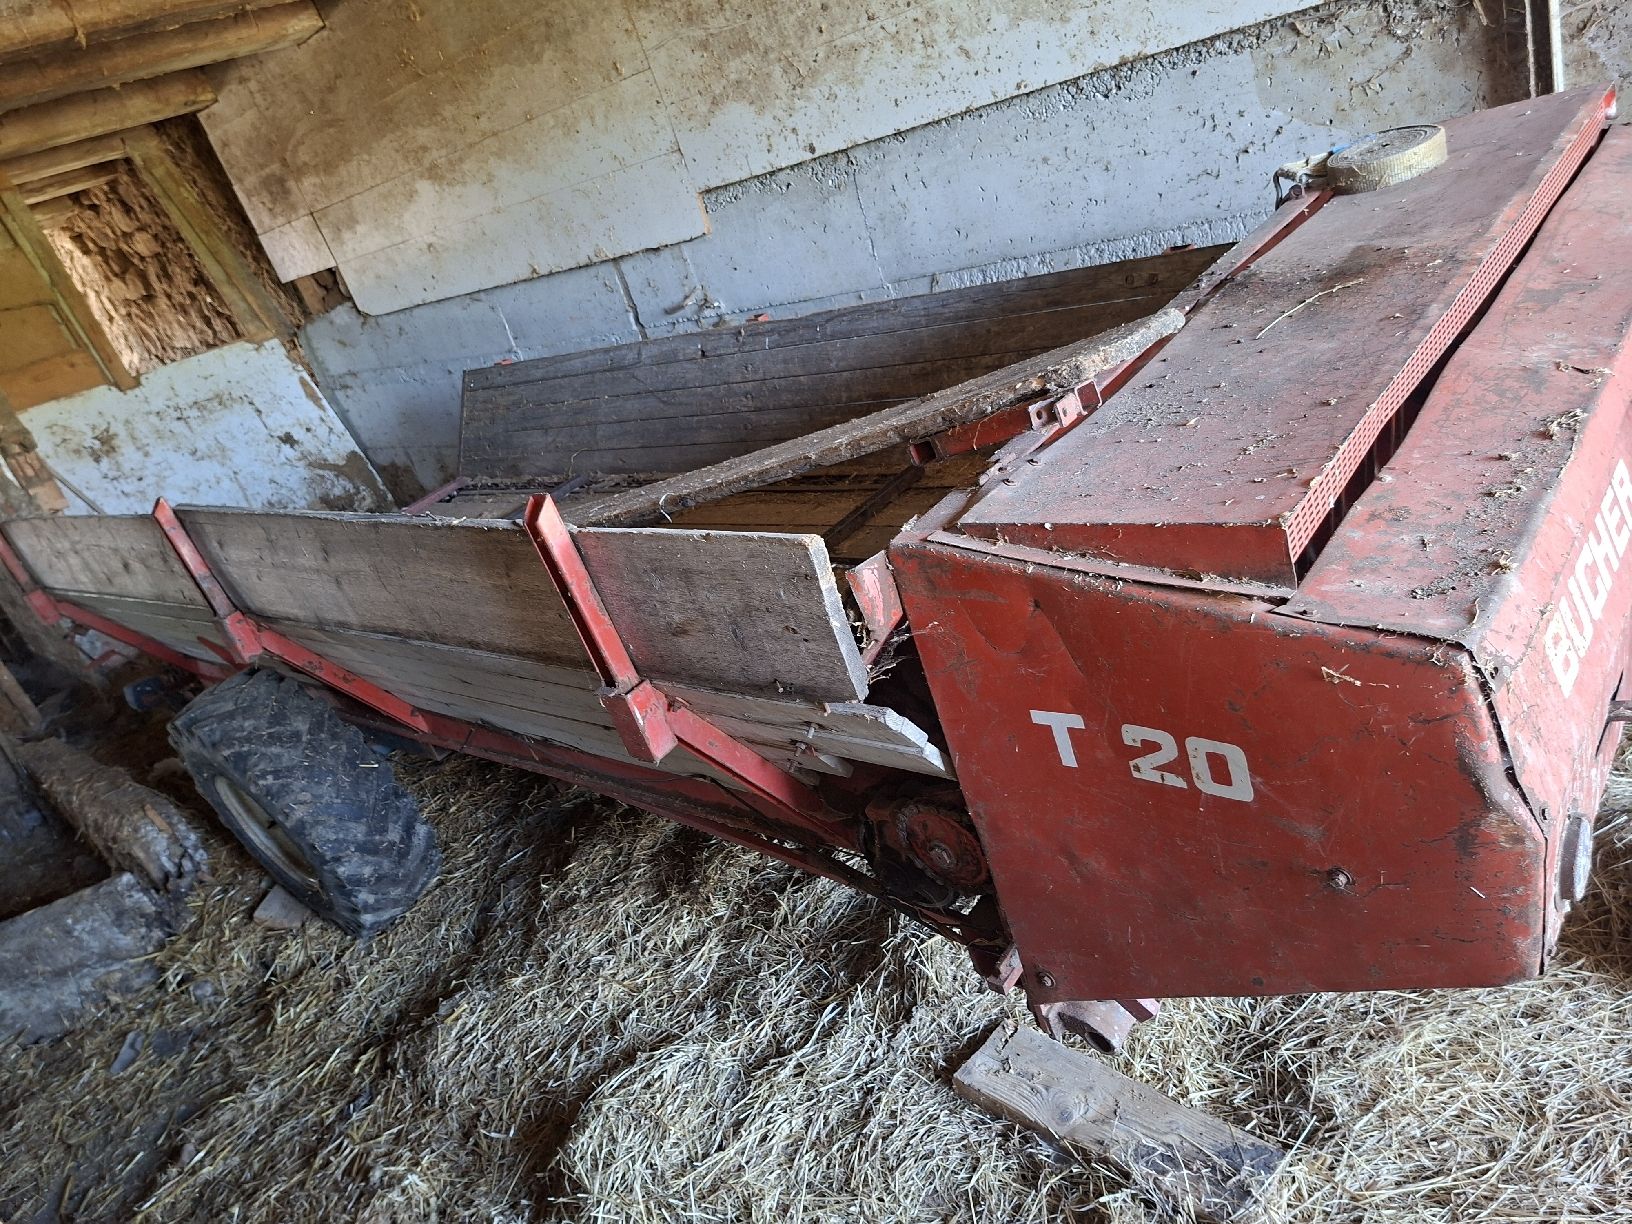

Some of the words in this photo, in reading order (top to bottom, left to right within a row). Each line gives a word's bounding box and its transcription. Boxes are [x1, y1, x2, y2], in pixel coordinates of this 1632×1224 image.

[1544, 458, 1632, 699] BUCHER
[1029, 709, 1085, 768] T
[1121, 723, 1254, 802] 20
